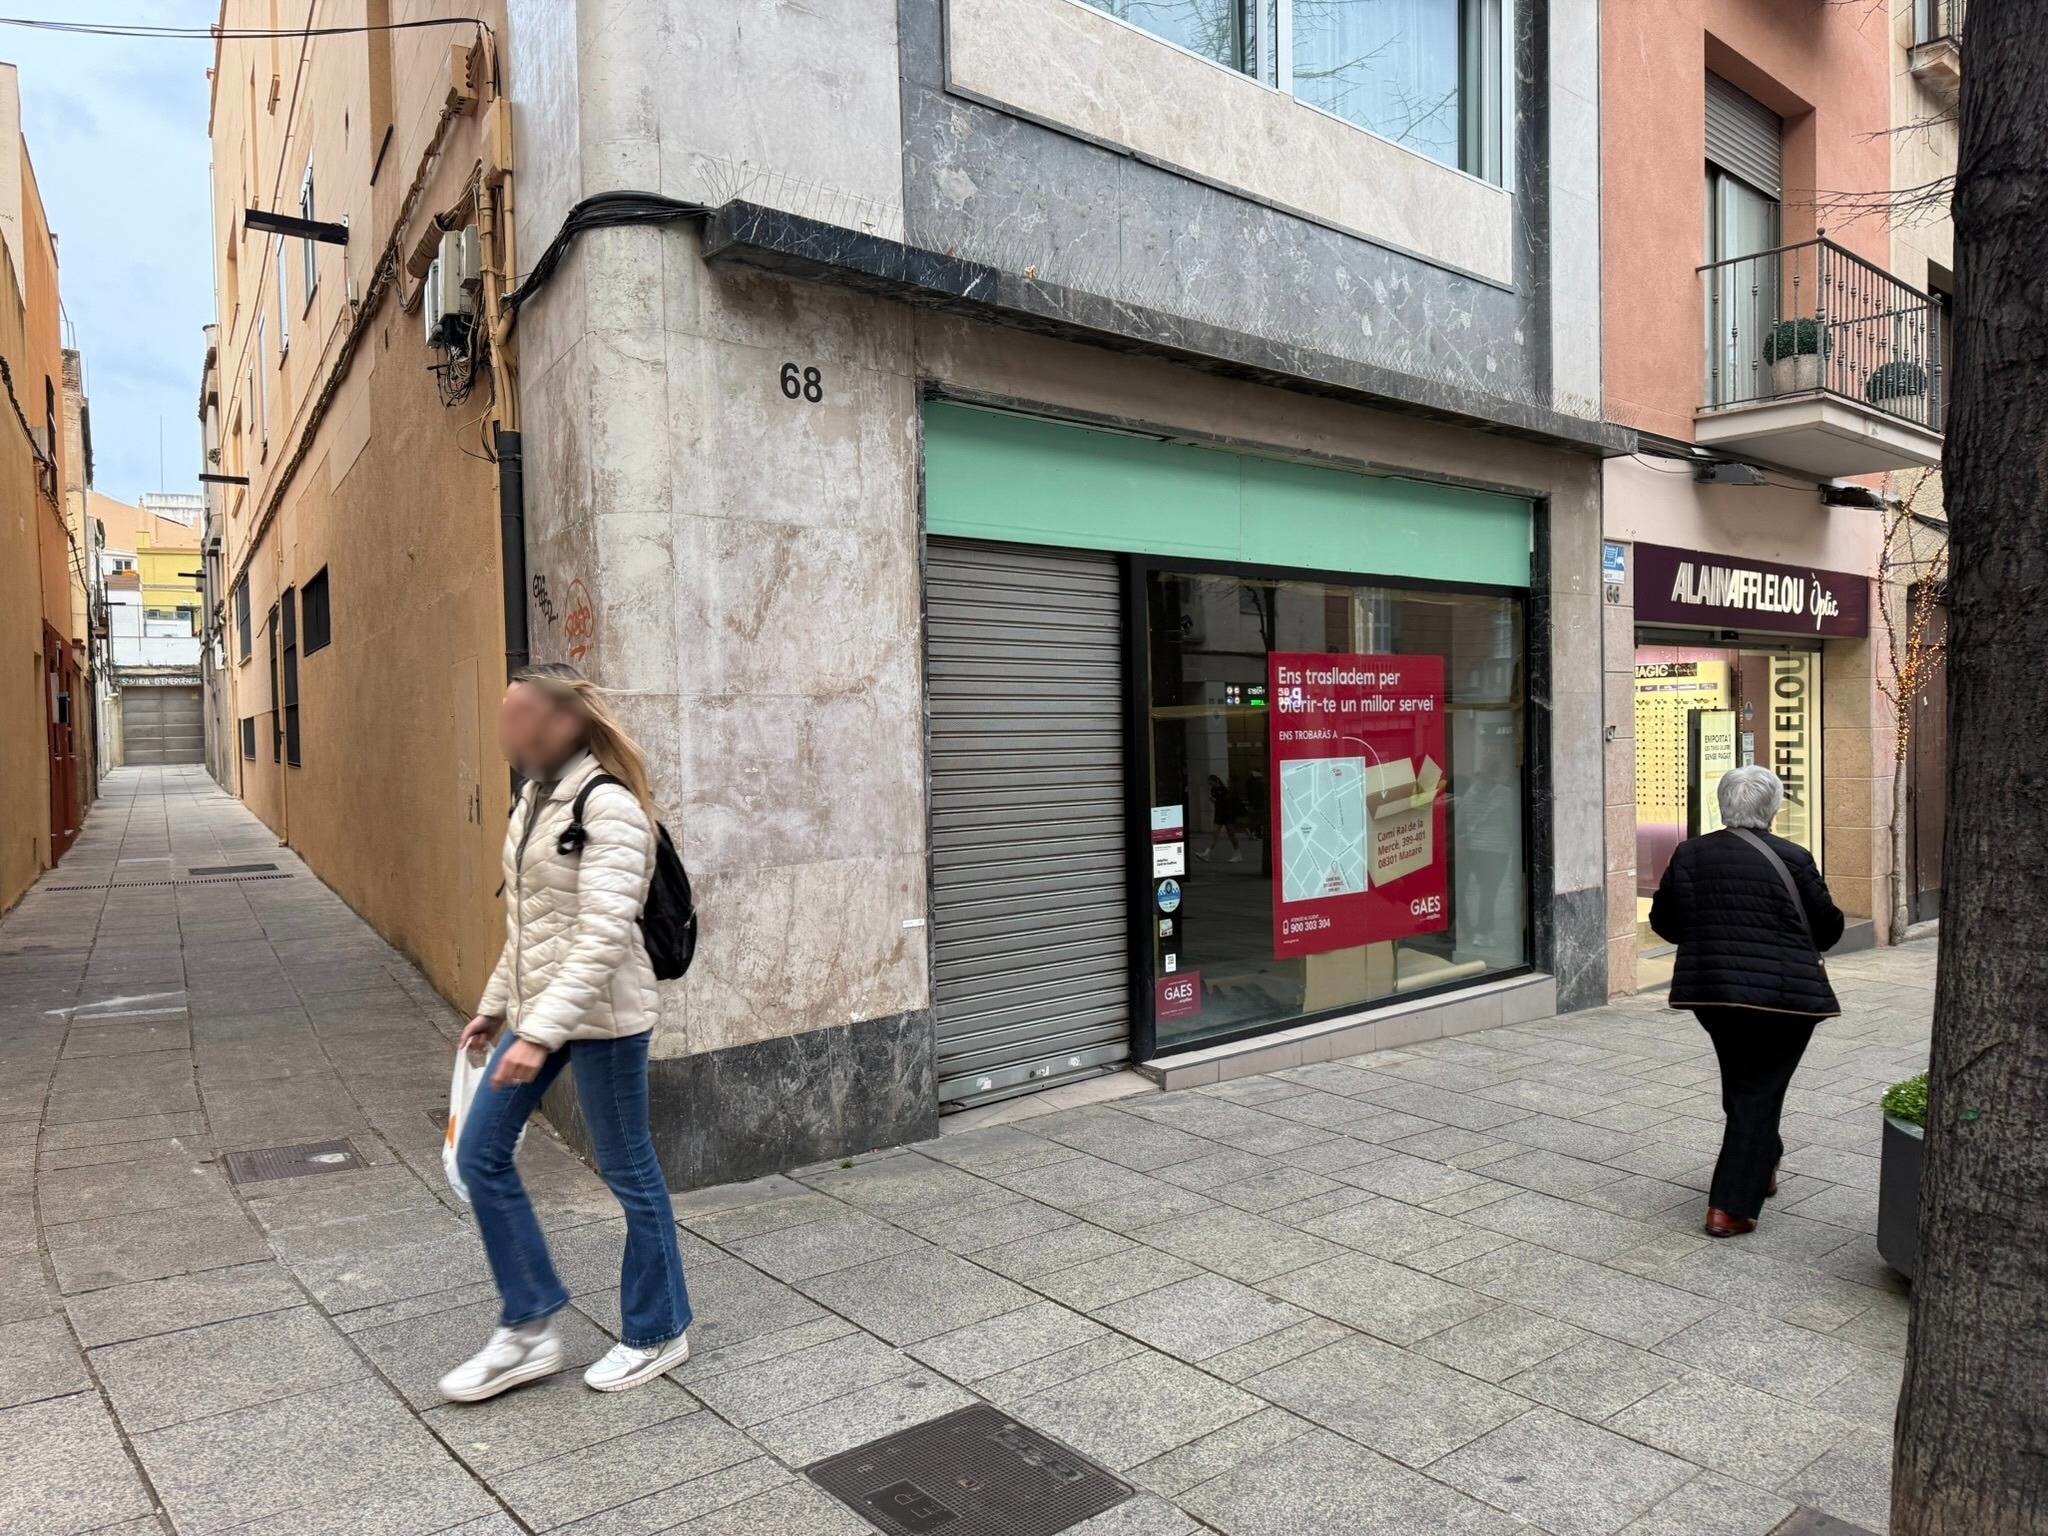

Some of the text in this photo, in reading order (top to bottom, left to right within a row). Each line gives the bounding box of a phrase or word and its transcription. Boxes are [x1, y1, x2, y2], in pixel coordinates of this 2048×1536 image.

[780, 362, 823, 403] 68
[1606, 584, 1620, 603] 66
[1810, 573, 1839, 631] Òptic
[1278, 667, 1400, 689] Ens traslladem per
[1341, 699, 1357, 712] un
[1361, 695, 1396, 712] millor
[1399, 694, 1434, 712] servei
[1279, 728, 1338, 741] ENS TROBARÀS A
[1396, 824, 1407, 836] Ral
[1408, 821, 1417, 831] de
[1417, 819, 1423, 828] la
[1402, 830, 1425, 847] 399-401
[1378, 843, 1422, 869] 08301 Mataró
[1410, 896, 1441, 916] GAES
[1290, 922, 1304, 934] 900
[1304, 919, 1317, 931] 303
[1318, 917, 1331, 929] 304
[1164, 983, 1193, 1001] GAES
